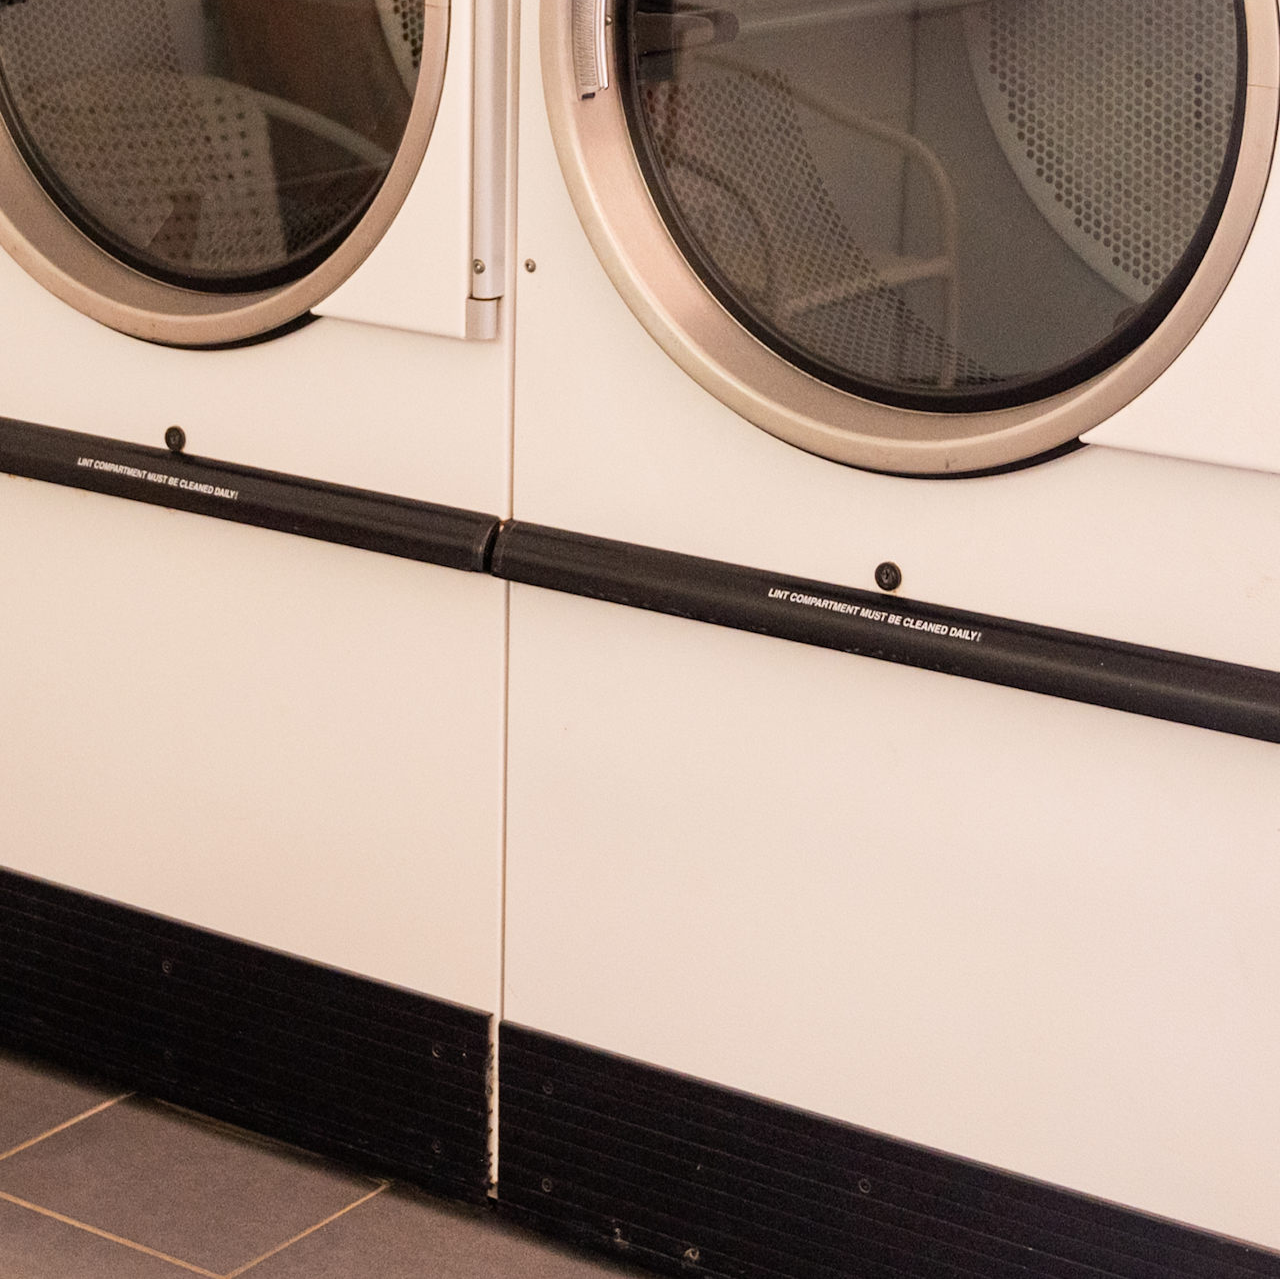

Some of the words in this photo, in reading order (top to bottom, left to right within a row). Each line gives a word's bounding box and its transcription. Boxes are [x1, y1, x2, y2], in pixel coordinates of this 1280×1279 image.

[77, 457, 94, 467] LINT
[94, 460, 148, 479] COMPARTMENT
[147, 472, 168, 484] MUST
[168, 477, 179, 486] BE
[180, 479, 214, 494] CLEANED
[214, 486, 238, 500] DAILY!
[768, 588, 790, 600] LINT
[790, 592, 860, 616] COMPARTMENT
[860, 608, 888, 622] MUST
[888, 614, 903, 626] BE
[903, 617, 949, 636] CLEANED
[949, 627, 982, 642] DAILY!
